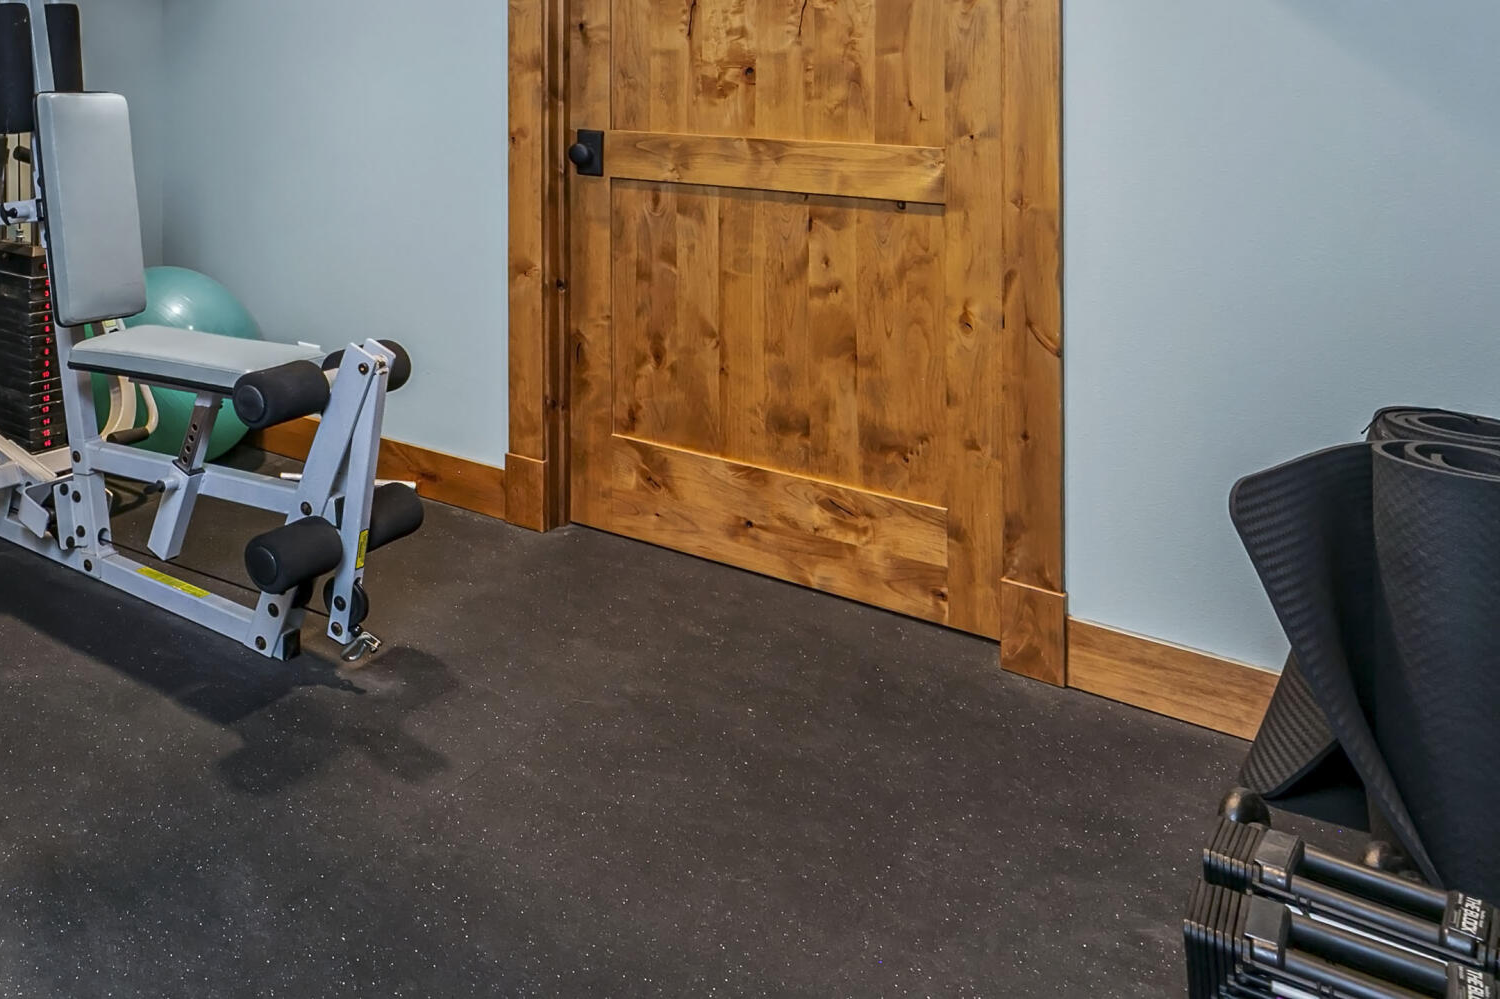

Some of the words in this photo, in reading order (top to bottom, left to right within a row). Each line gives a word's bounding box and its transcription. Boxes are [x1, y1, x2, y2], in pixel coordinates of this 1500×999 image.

[41, 370, 50, 378] 10
[42, 383, 50, 391] 11
[42, 394, 50, 403] 12
[1465, 896, 1482, 912] THE
[1461, 908, 1480, 935] BLOCK
[1467, 969, 1484, 988] THE
